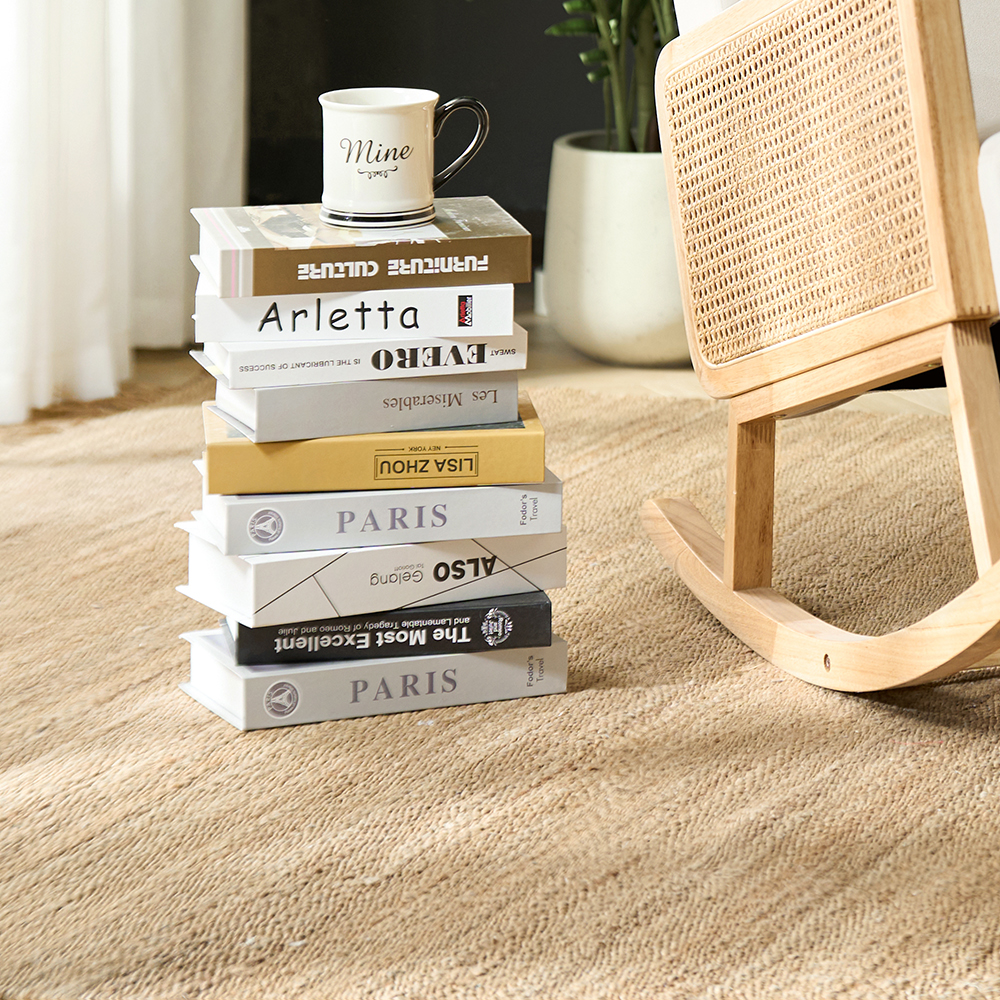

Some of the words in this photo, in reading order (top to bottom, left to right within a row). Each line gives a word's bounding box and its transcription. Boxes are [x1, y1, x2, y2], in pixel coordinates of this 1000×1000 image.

[340, 138, 414, 164] Mine
[297, 260, 379, 280] CULTURE
[257, 297, 420, 333] Arletta
[370, 342, 488, 371] EVERO
[490, 348, 517, 356] SWEAT
[238, 363, 276, 373] SUCCESS
[277, 362, 289, 370] OF
[290, 359, 335, 369] LUBRICANT
[336, 358, 352, 367] THE
[353, 358, 361, 366] IS
[382, 392, 463, 412] Miserables
[472, 389, 498, 404] Les
[380, 459, 430, 475] ZHOU
[434, 458, 473, 472] LISA
[529, 497, 538, 521] Travel
[335, 502, 449, 535] PARIS
[432, 555, 498, 583] ALSO
[369, 570, 424, 586] Gelang
[319, 624, 351, 634] Romeo
[352, 624, 362, 632] of
[363, 619, 399, 632] Tragedy
[401, 618, 452, 629] Lamentable
[453, 617, 470, 626] and
[300, 627, 317, 636] and
[375, 628, 427, 649] Most
[432, 625, 472, 644] The
[273, 632, 371, 653] Excellent
[535, 658, 544, 682] Travel
[349, 667, 459, 705] PARIS
